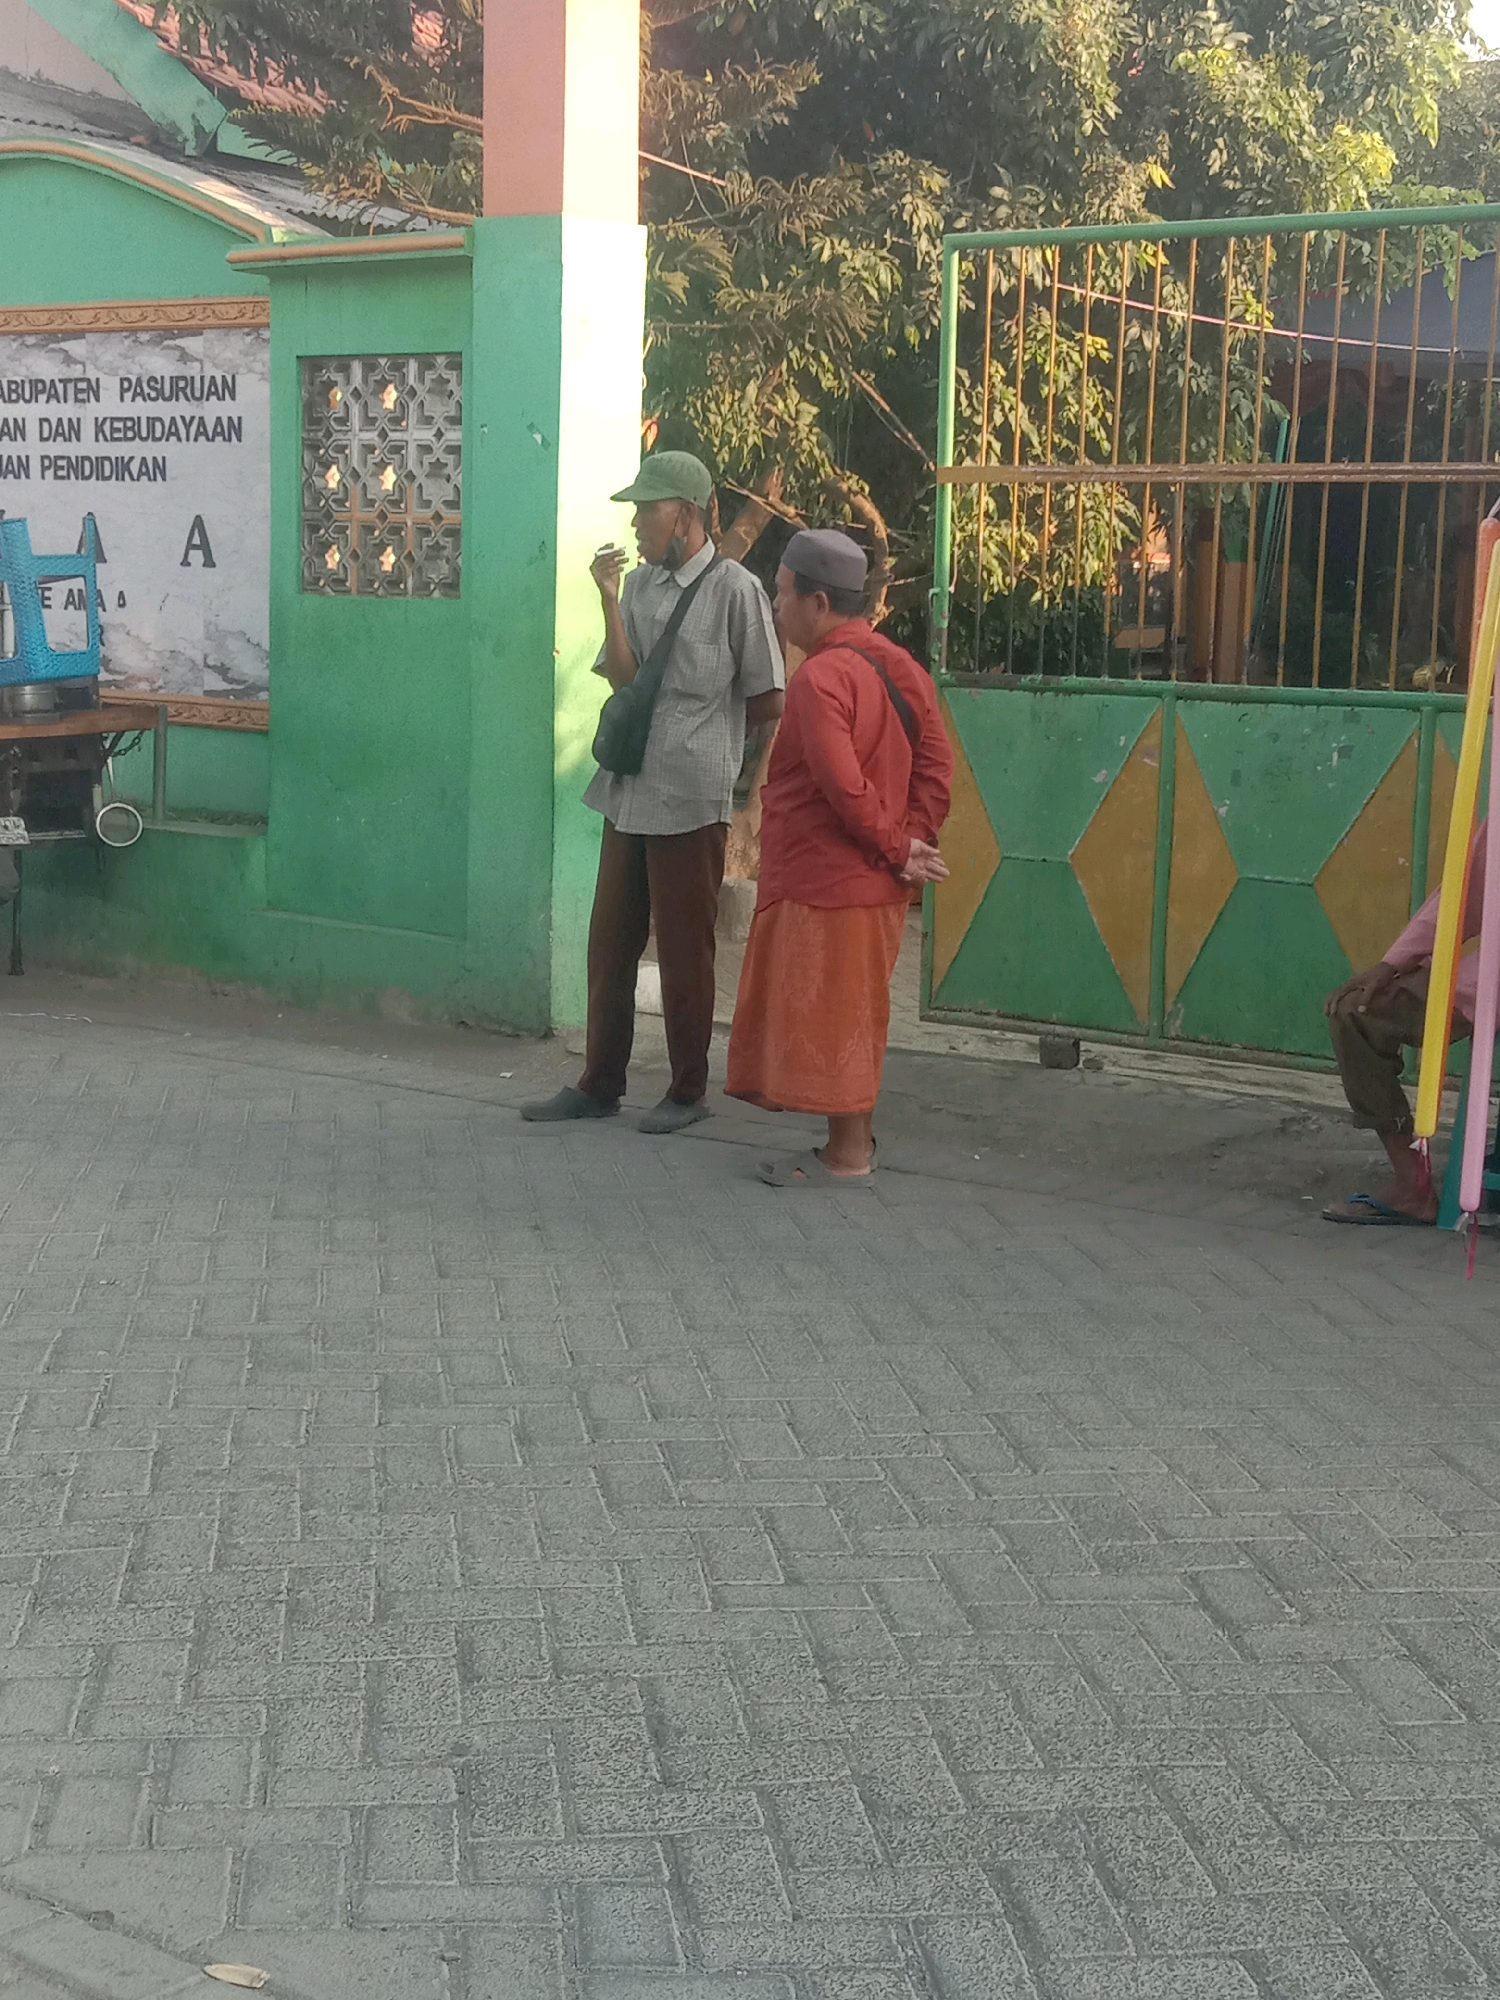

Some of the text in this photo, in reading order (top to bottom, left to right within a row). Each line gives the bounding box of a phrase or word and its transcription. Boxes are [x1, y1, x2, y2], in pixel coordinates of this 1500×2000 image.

[119, 374, 236, 402] PASURUAN
[0, 415, 242, 442] AN DAN KEBUDAYAAN
[0, 454, 166, 481] AN PENDIDIKAN
[180, 514, 216, 568] A
